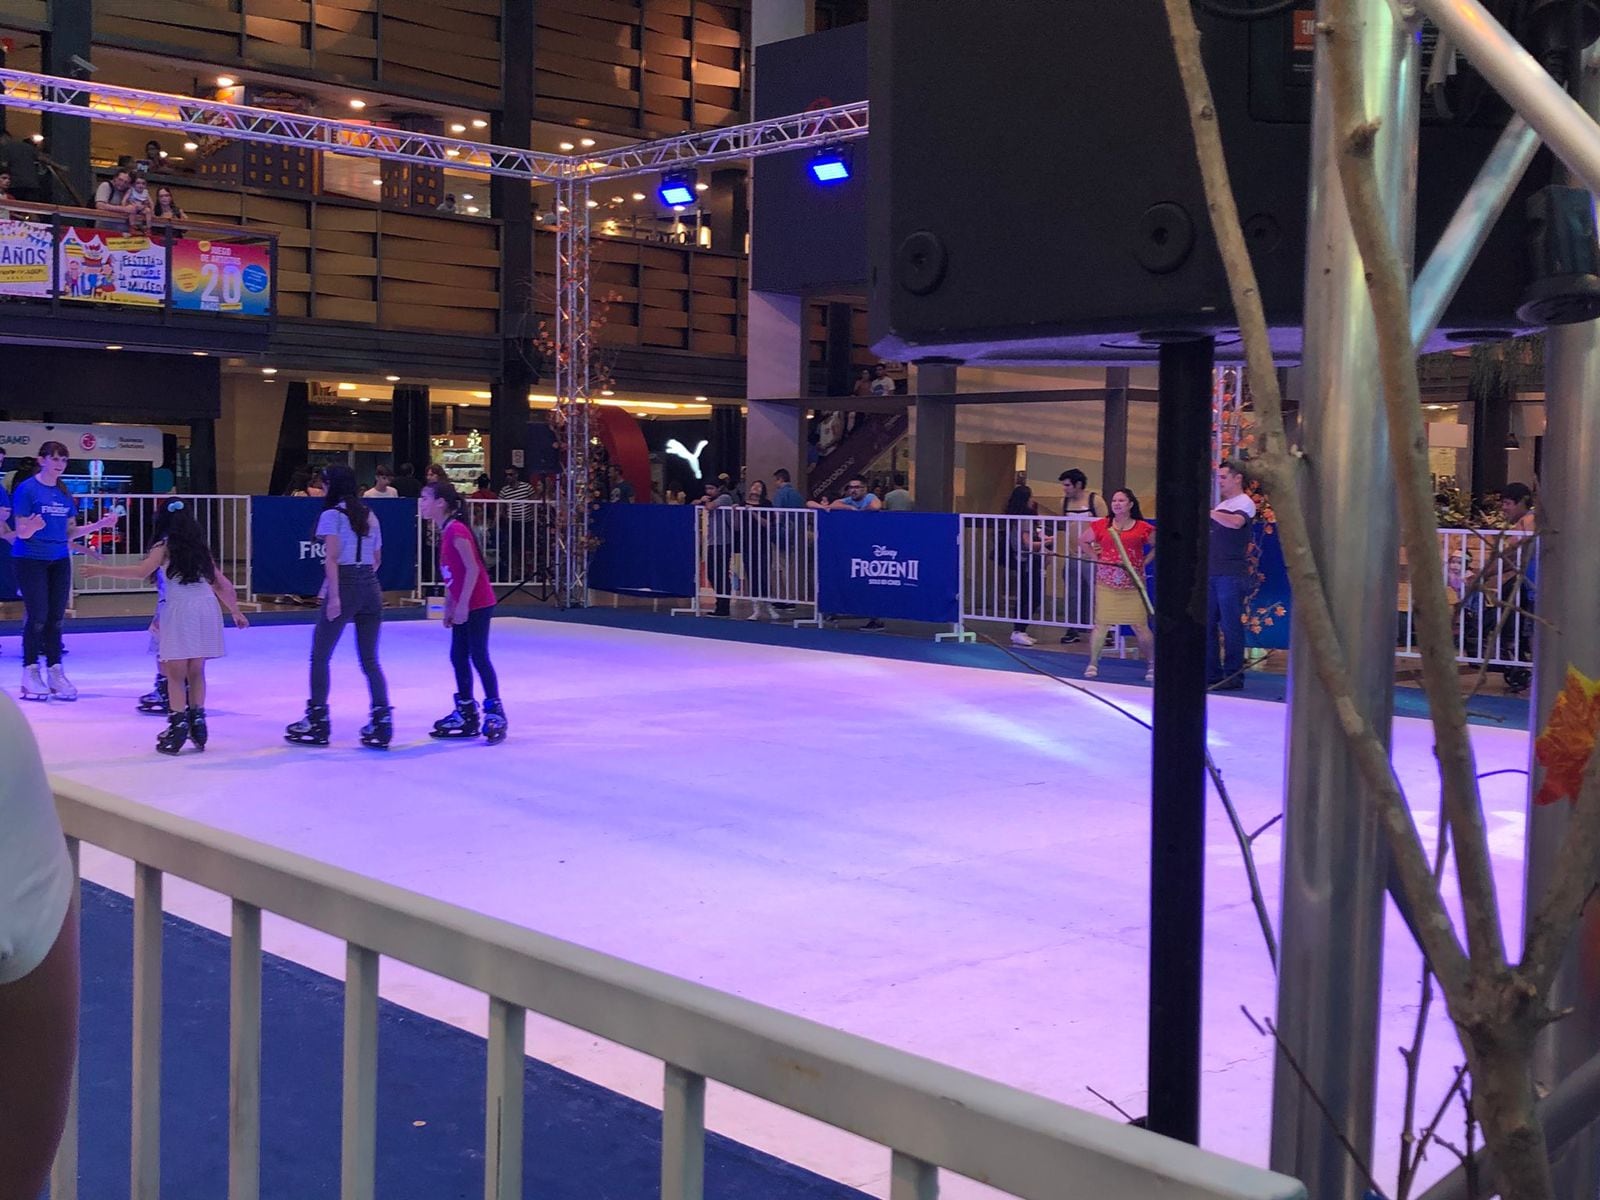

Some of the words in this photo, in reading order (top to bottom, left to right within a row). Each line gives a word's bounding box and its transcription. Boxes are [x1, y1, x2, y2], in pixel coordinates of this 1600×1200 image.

[1, 246, 46, 265] AÑOS
[201, 263, 241, 304] 20
[850, 558, 907, 578] FROZEN
[907, 560, 919, 580] II
